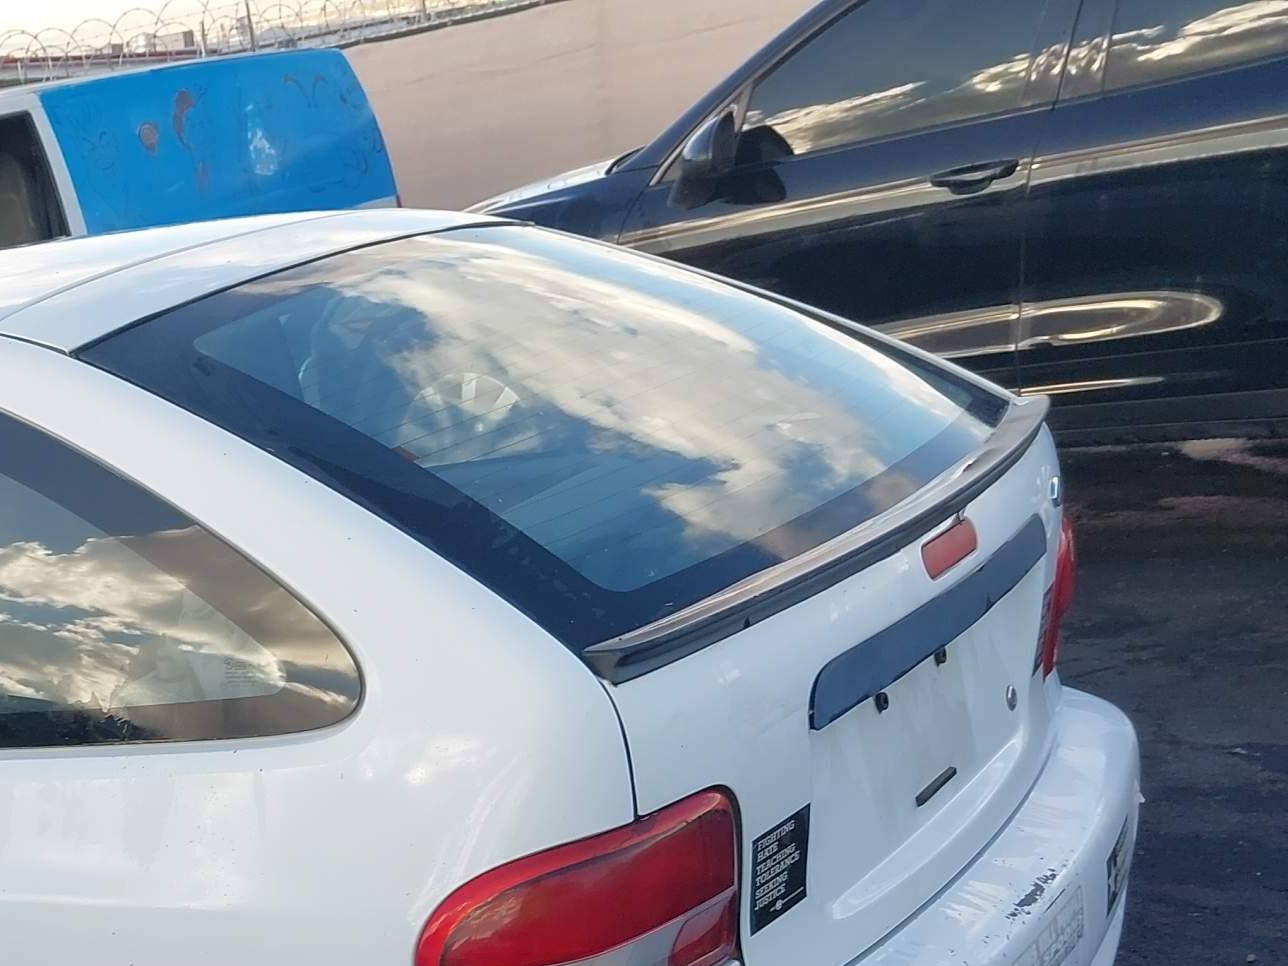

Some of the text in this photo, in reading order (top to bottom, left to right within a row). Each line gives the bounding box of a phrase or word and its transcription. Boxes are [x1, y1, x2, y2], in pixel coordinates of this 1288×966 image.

[757, 819, 795, 851] FIGHTING
[756, 842, 796, 875] TEACHING
[757, 841, 779, 862] HATE
[755, 850, 800, 886] TOLERANCE
[754, 882, 786, 910] JUSTICE
[755, 871, 788, 899] SEEKING
